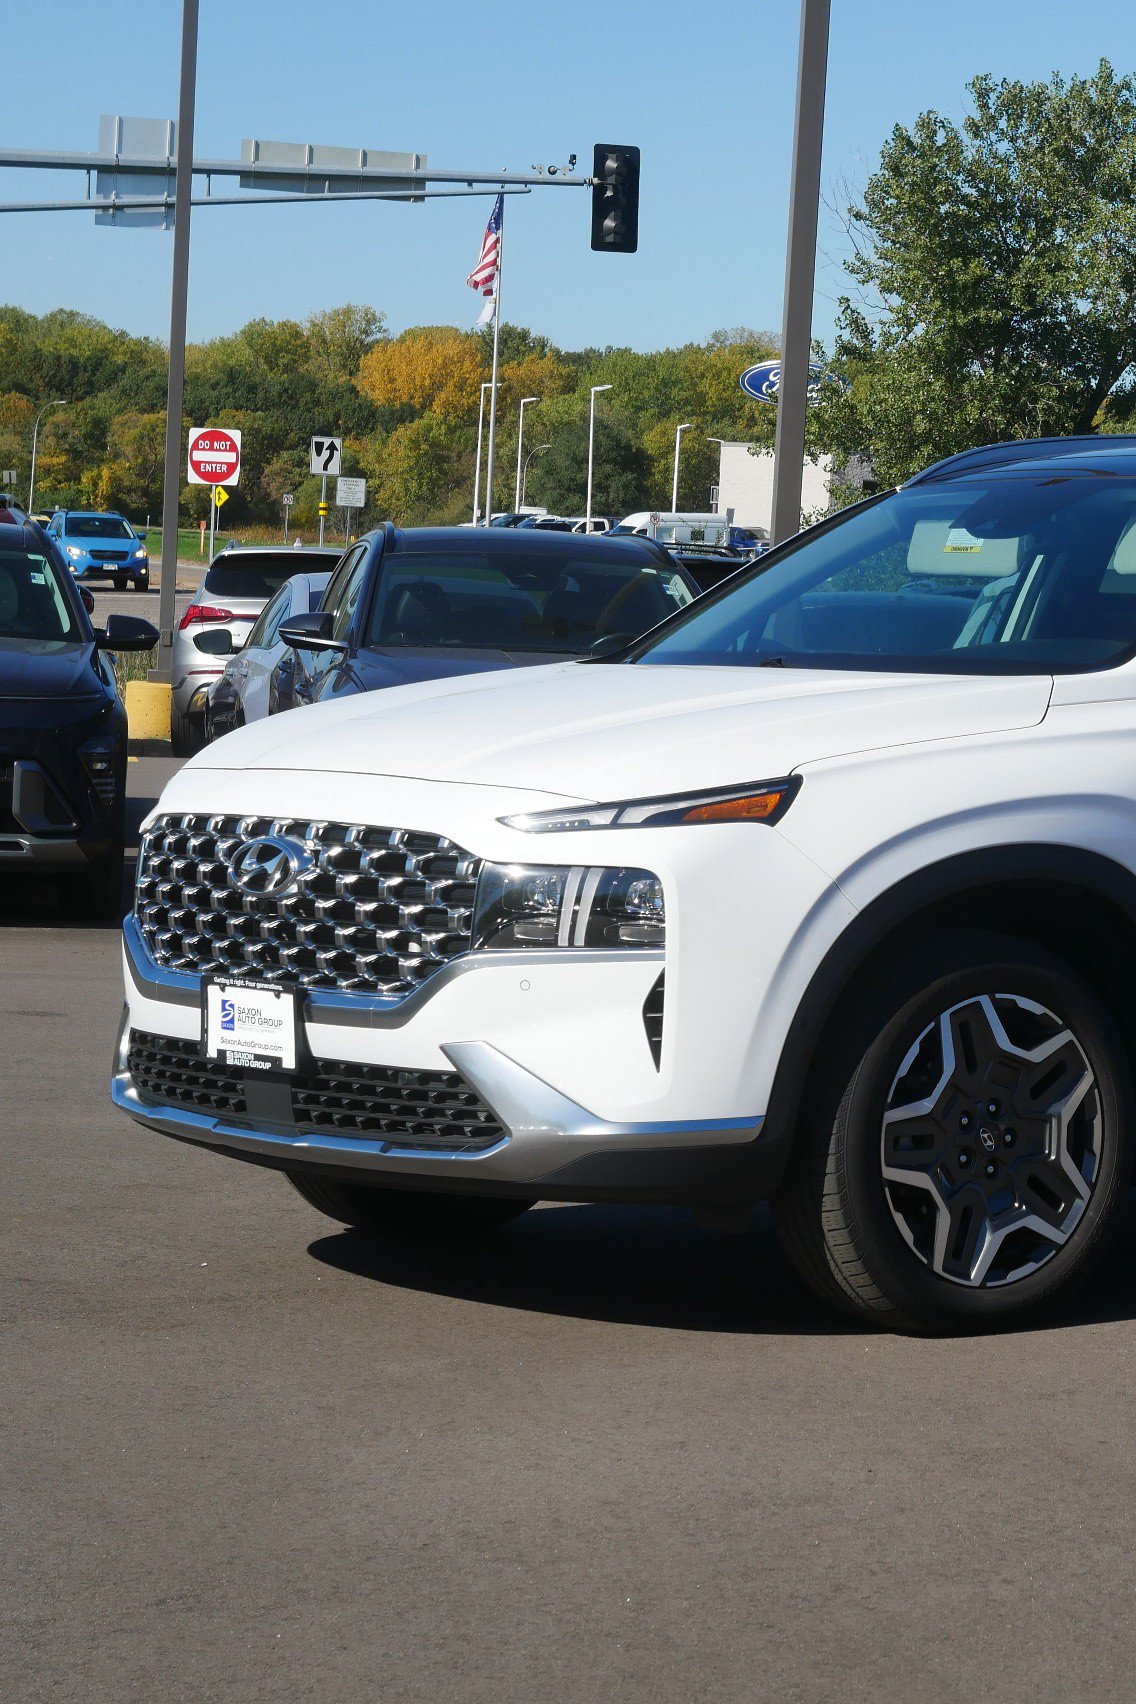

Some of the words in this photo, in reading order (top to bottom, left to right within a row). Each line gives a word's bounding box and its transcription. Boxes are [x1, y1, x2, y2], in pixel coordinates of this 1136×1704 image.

[198, 440, 210, 449] DO
[213, 441, 231, 450] NOT
[200, 463, 228, 473] ENTER
[214, 976, 230, 985] Getting
[237, 1006, 262, 1017] SAXON
[237, 1015, 256, 1025] AUTO
[258, 1018, 283, 1028] GROUP
[220, 1036, 284, 1052] SaxonAutoGroup.com
[234, 1052, 254, 1060] SAXON
[234, 1058, 250, 1066] AUTO
[250, 1060, 272, 1070] GROUP
